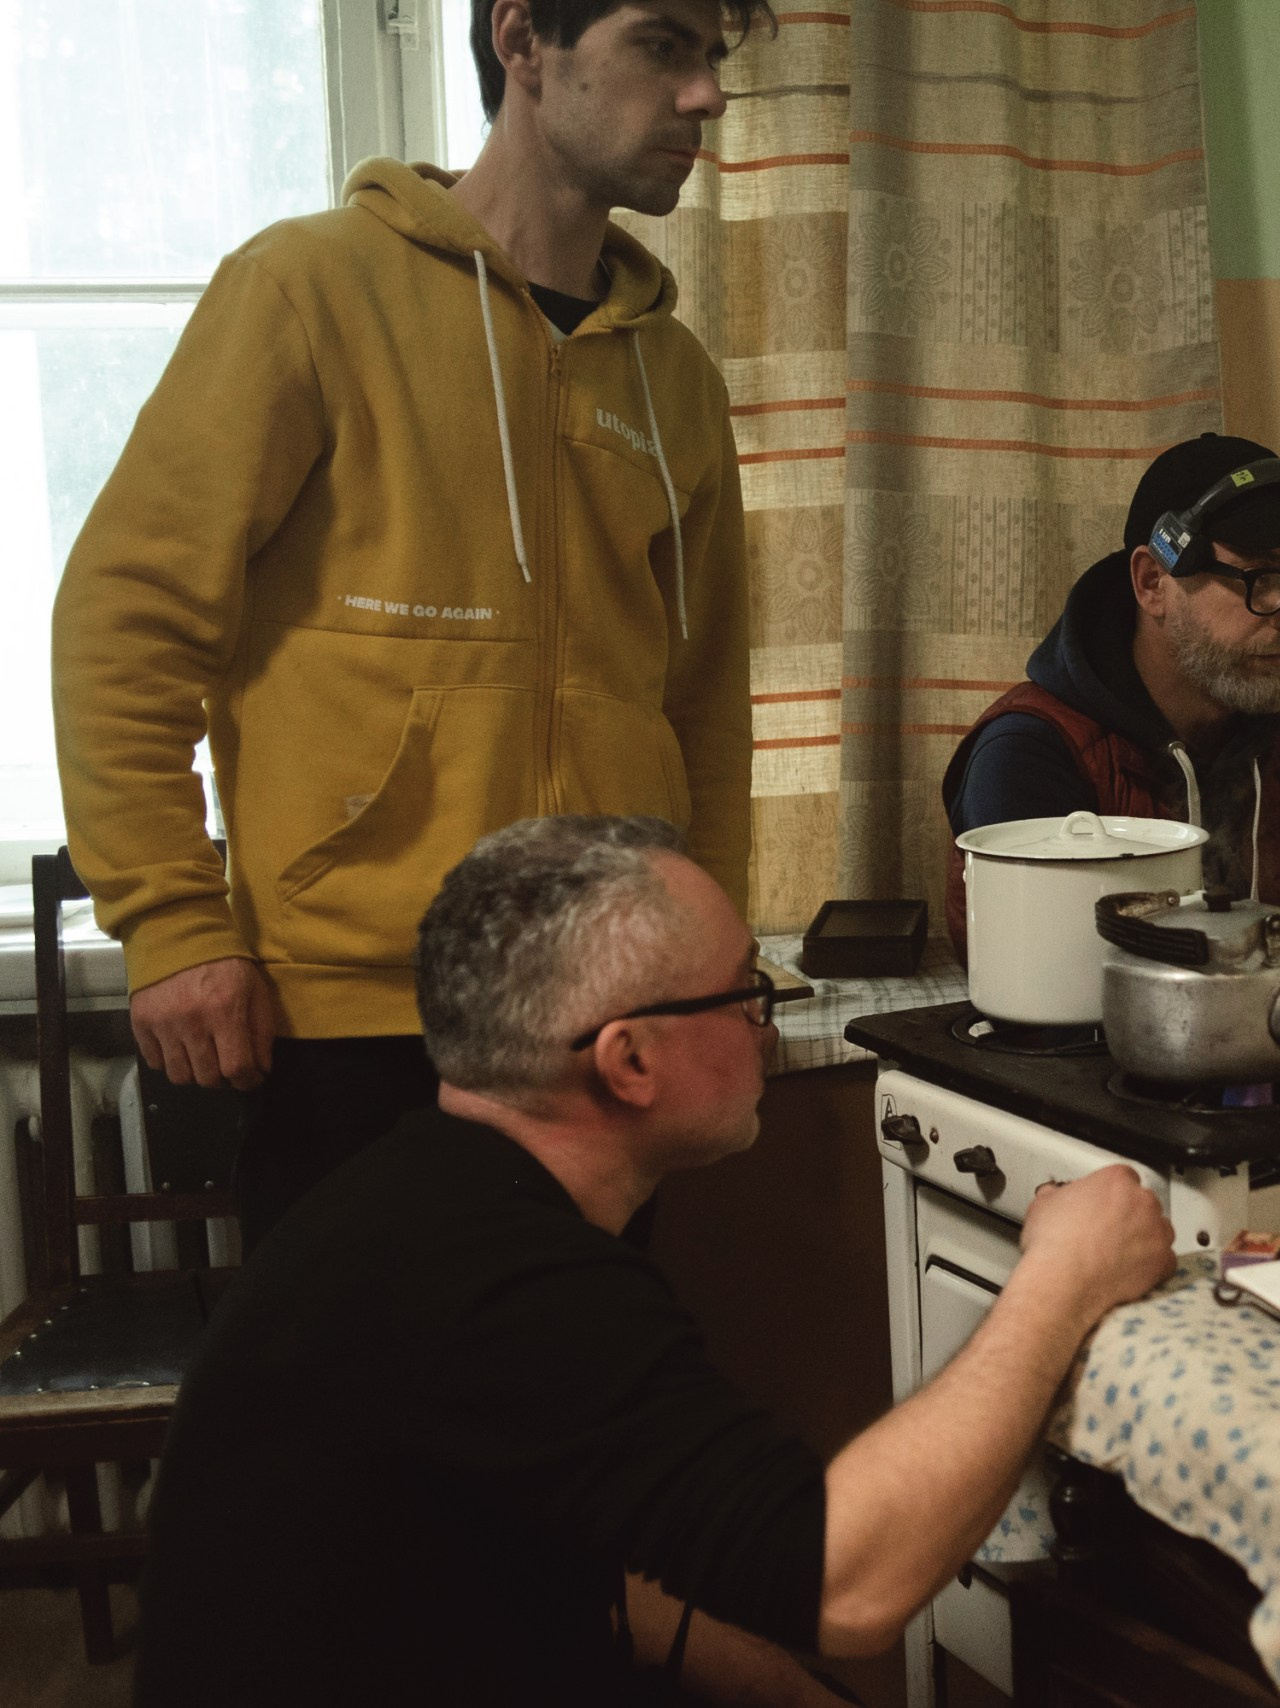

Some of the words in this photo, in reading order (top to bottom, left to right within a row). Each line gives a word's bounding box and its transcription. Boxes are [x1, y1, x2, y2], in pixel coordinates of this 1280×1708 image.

[596, 408, 658, 457] utopia
[344, 594, 382, 611] HERE
[384, 601, 409, 615] WE
[412, 605, 437, 618] GO
[441, 607, 492, 620] AGAIN
